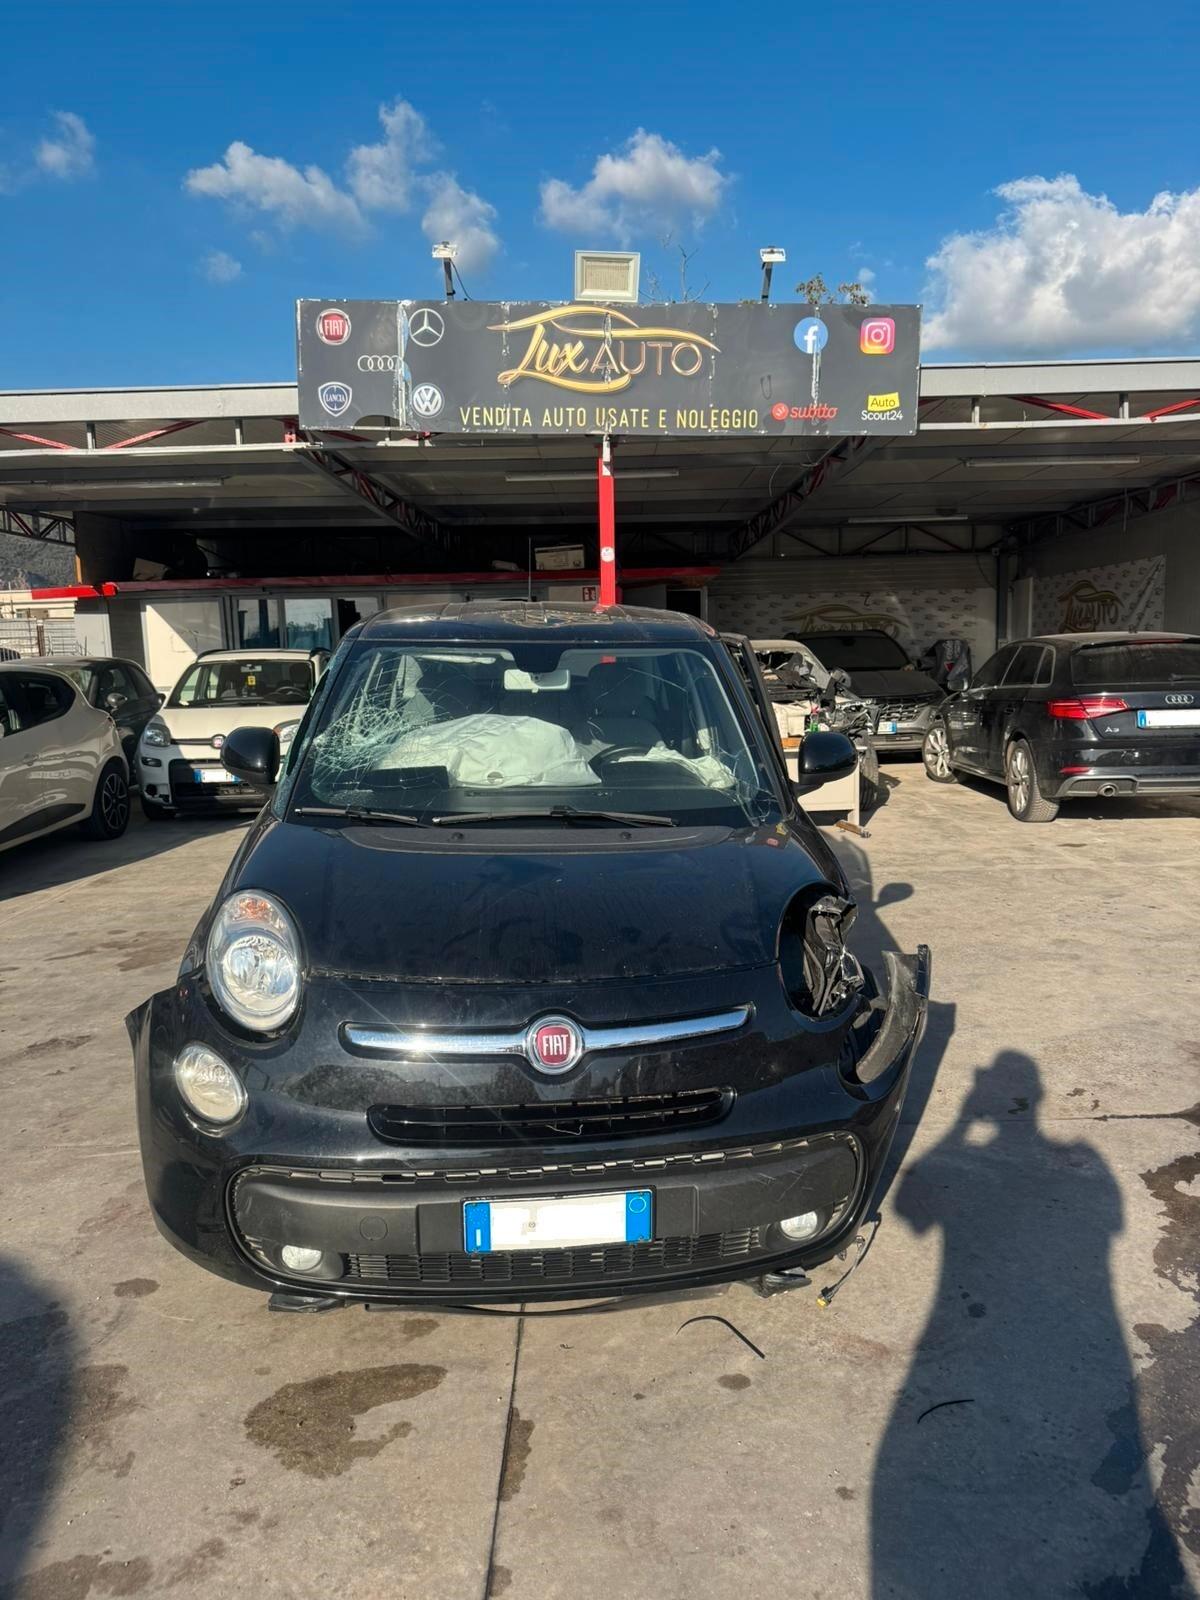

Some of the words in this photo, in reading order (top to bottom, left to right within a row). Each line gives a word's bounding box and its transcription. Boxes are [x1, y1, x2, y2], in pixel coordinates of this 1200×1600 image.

[324, 319, 344, 337] FIAT
[590, 340, 702, 376] AUTO
[326, 394, 346, 402] LANCIA
[870, 397, 896, 408] Auto
[459, 407, 532, 427] VENDITA
[542, 407, 586, 428] AUTO
[595, 408, 649, 428] USATE
[658, 409, 667, 428] E
[676, 409, 758, 429] NOLEGGIO
[861, 410, 903, 420] Scout24
[542, 1034, 569, 1056] FIAT
